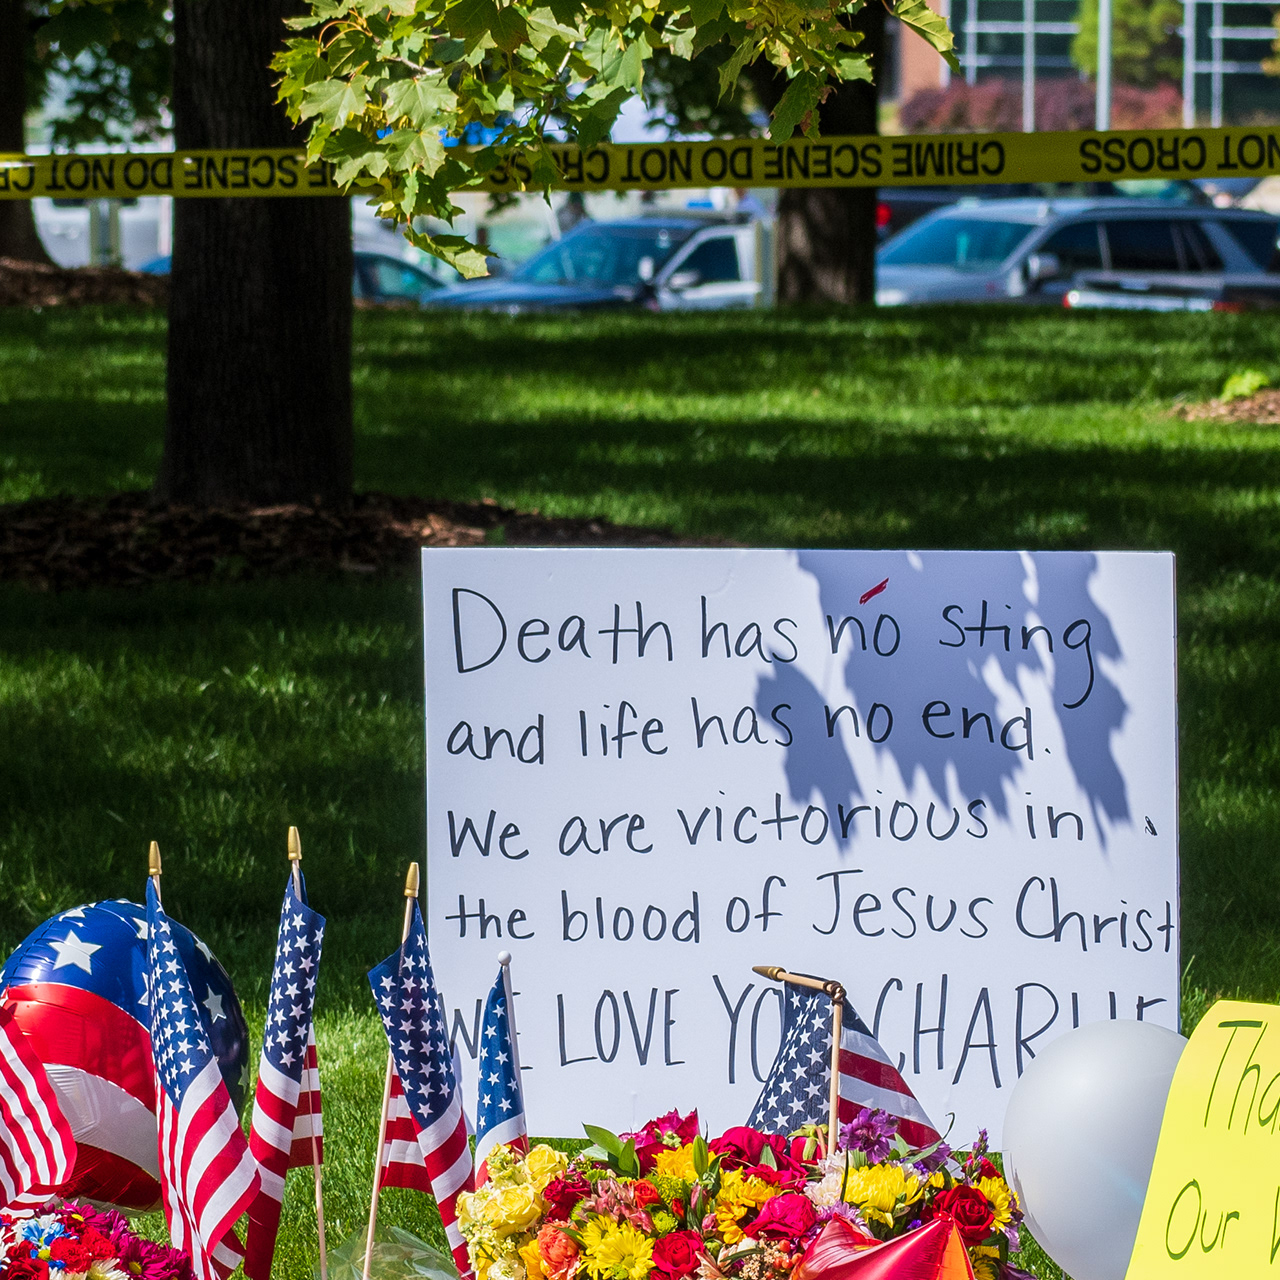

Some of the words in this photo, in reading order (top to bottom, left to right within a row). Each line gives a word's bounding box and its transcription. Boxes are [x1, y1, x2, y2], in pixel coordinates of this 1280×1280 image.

[123, 156, 174, 190] DO
[184, 154, 300, 190] SCENE
[622, 147, 694, 183] NOT
[701, 145, 753, 182] DO
[764, 142, 882, 180] SCENE
[892, 140, 1006, 177] CRIME
[1079, 136, 1207, 174] CROSS
[46, 157, 116, 192] NOT
[452, 587, 673, 674] Death
[700, 595, 799, 663] has
[827, 612, 902, 658] no
[447, 713, 545, 764] and
[579, 700, 668, 759] life
[692, 696, 794, 750] has
[825, 702, 892, 744] no
[923, 700, 1052, 760] end.
[448, 808, 530, 860] We
[558, 811, 654, 856] are
[678, 791, 989, 847] victorious
[1026, 792, 1084, 841] in
[447, 894, 535, 942] the
[561, 891, 701, 943] blood
[726, 875, 787, 934] of
[812, 868, 993, 939] Jesus
[1015, 876, 1176, 953] Christ
[556, 986, 686, 1067] LOVE
[712, 975, 786, 1085] YO
[1165, 1178, 1240, 1261] Our
